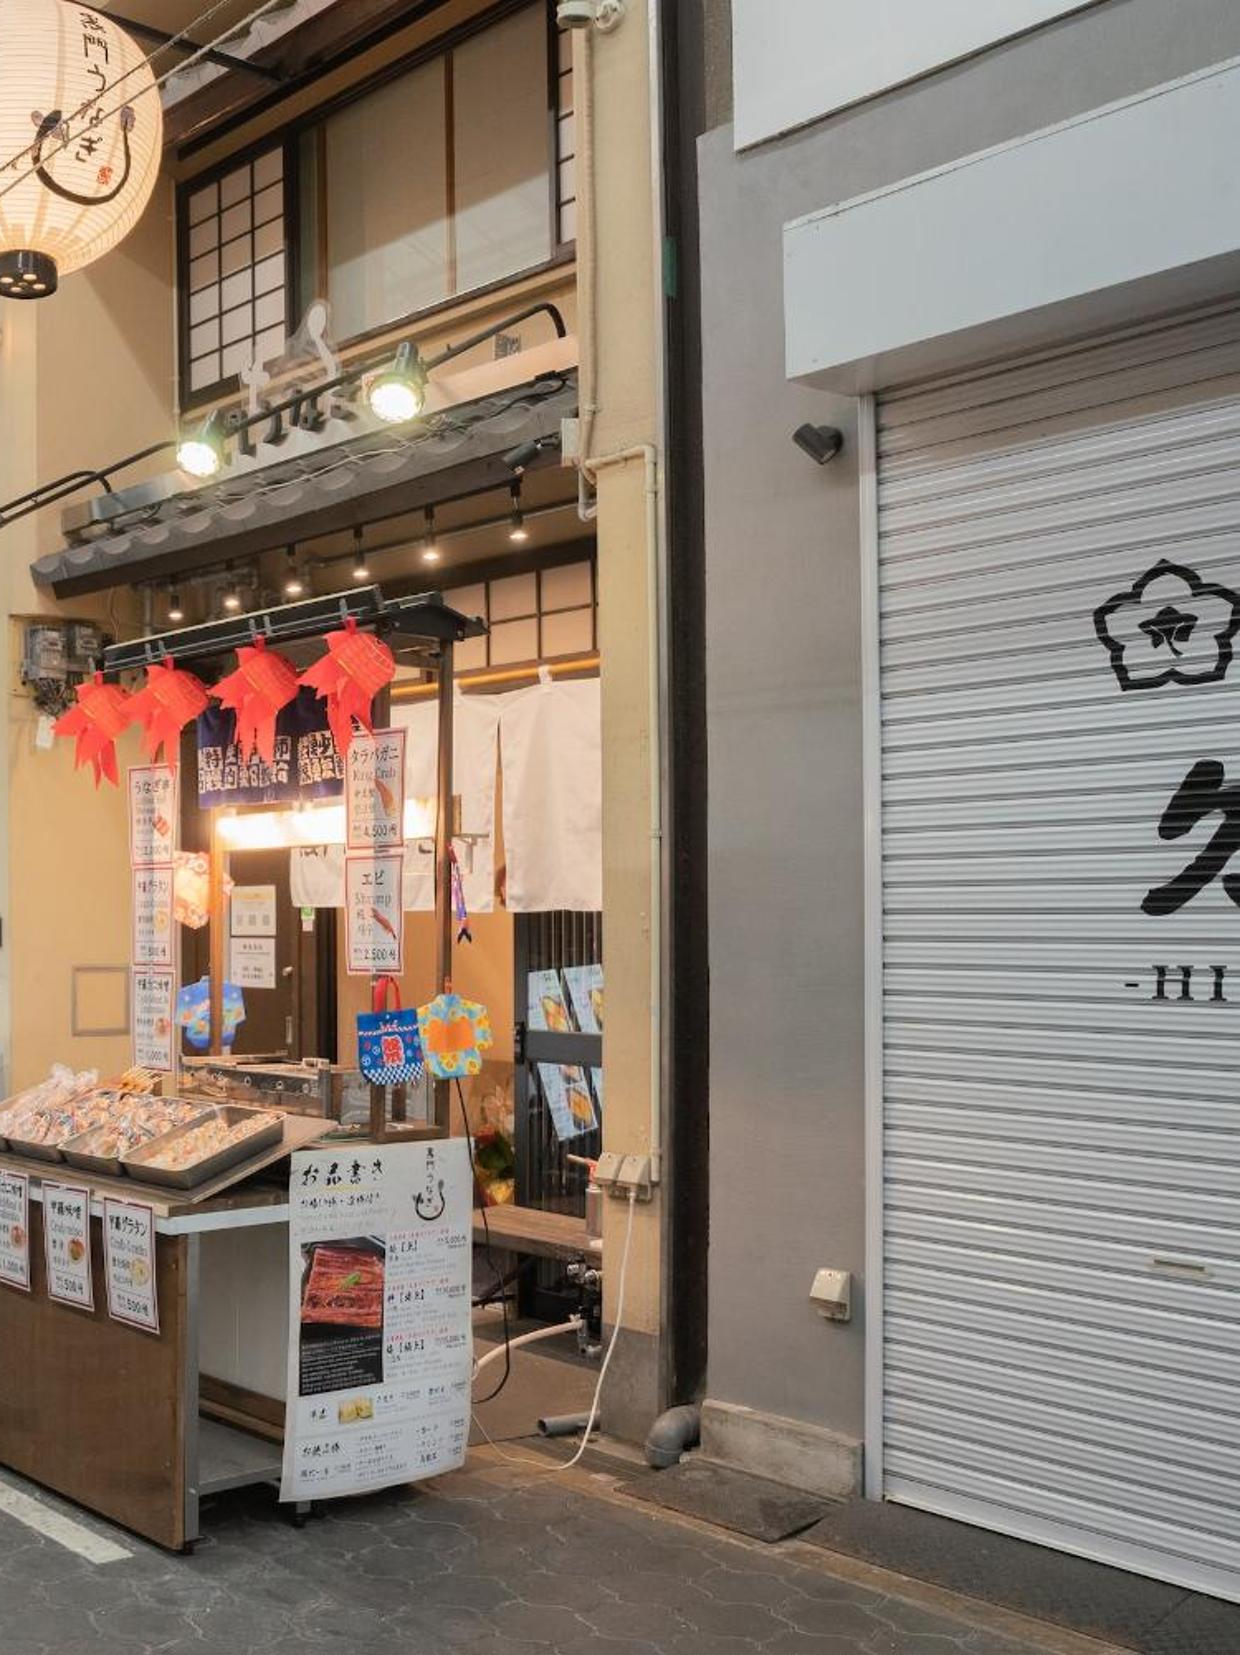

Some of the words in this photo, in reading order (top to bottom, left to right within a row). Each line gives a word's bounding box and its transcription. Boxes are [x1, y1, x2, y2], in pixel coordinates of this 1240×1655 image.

[361, 868, 385, 886] エビ
[301, 1157, 384, 1188] お品書き
